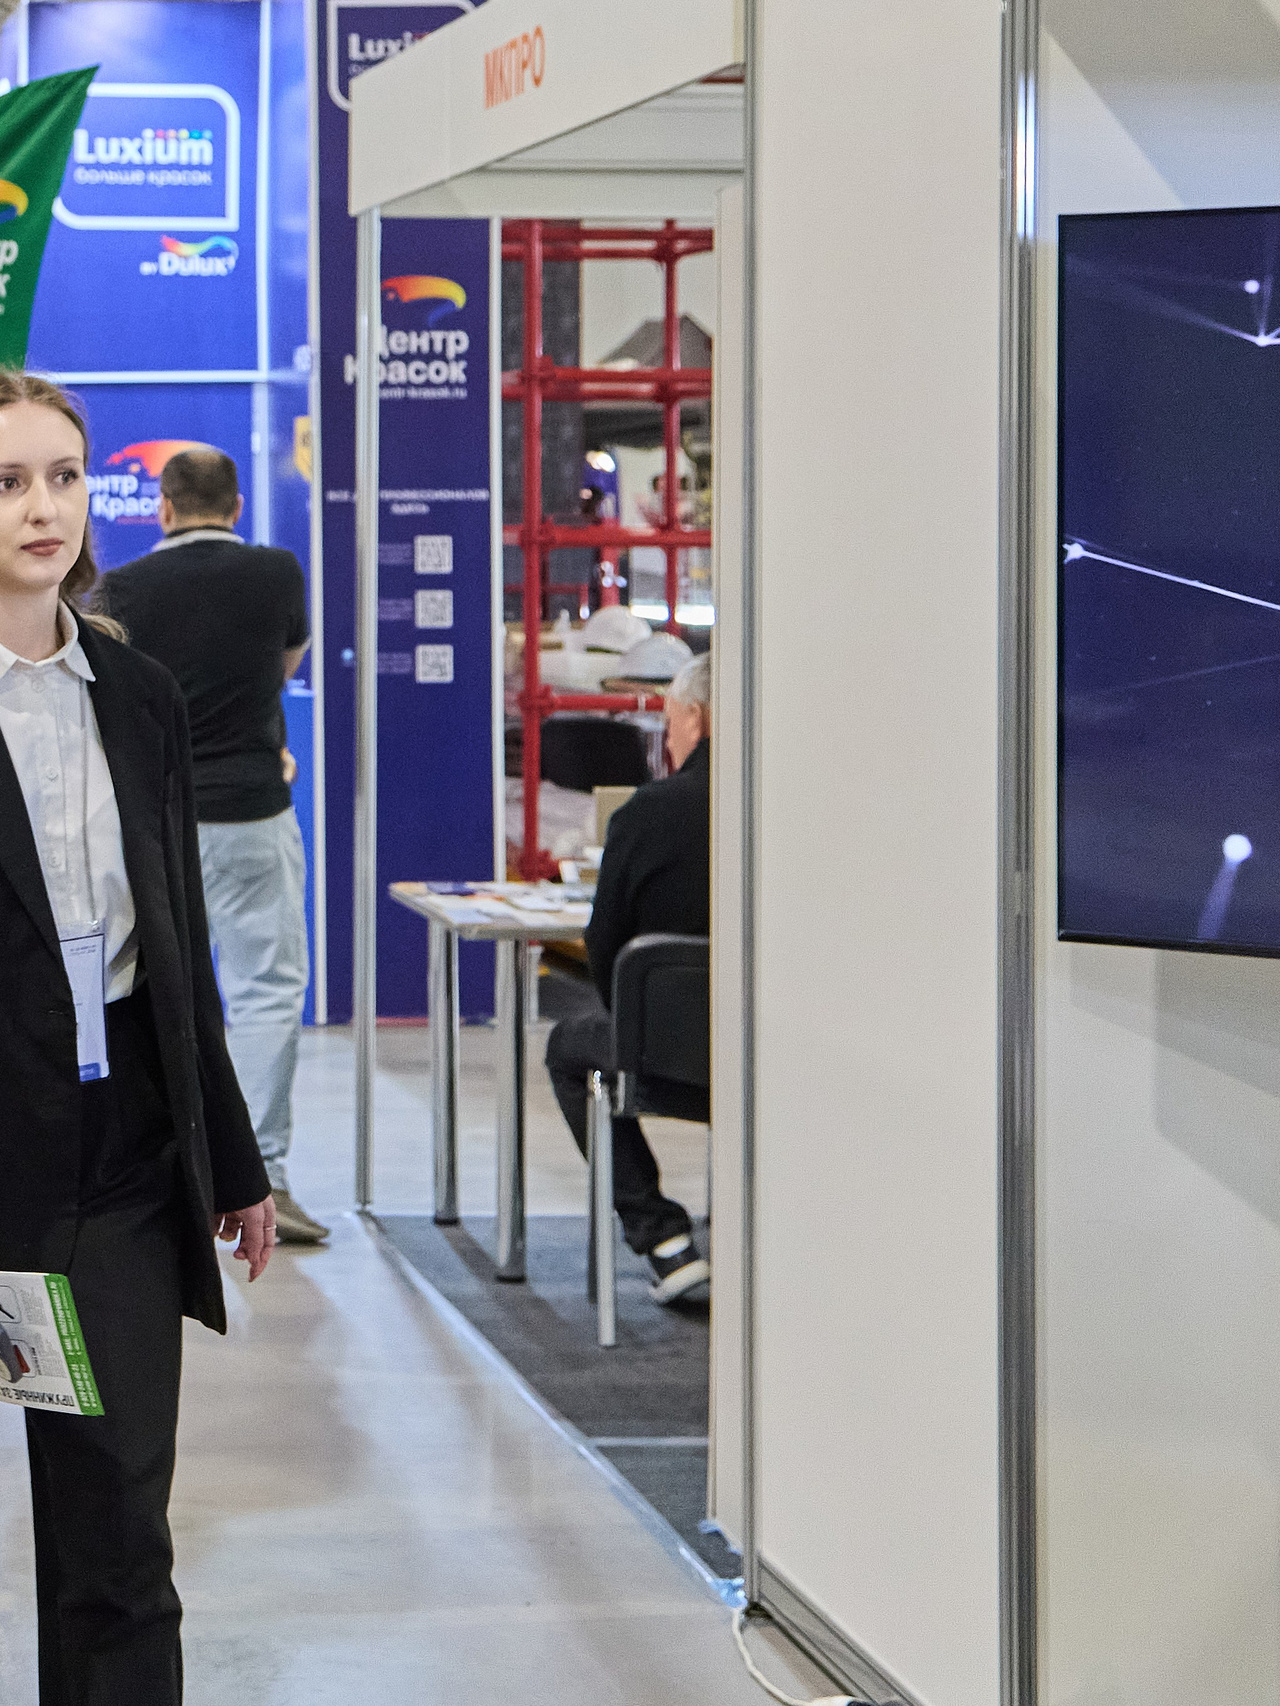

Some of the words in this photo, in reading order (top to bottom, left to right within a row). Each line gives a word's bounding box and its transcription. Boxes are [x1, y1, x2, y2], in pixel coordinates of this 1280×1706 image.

[74, 128, 213, 165] Luxium
[74, 167, 145, 184] больше
[147, 170, 212, 187] красок
[92, 493, 161, 521] Крас
